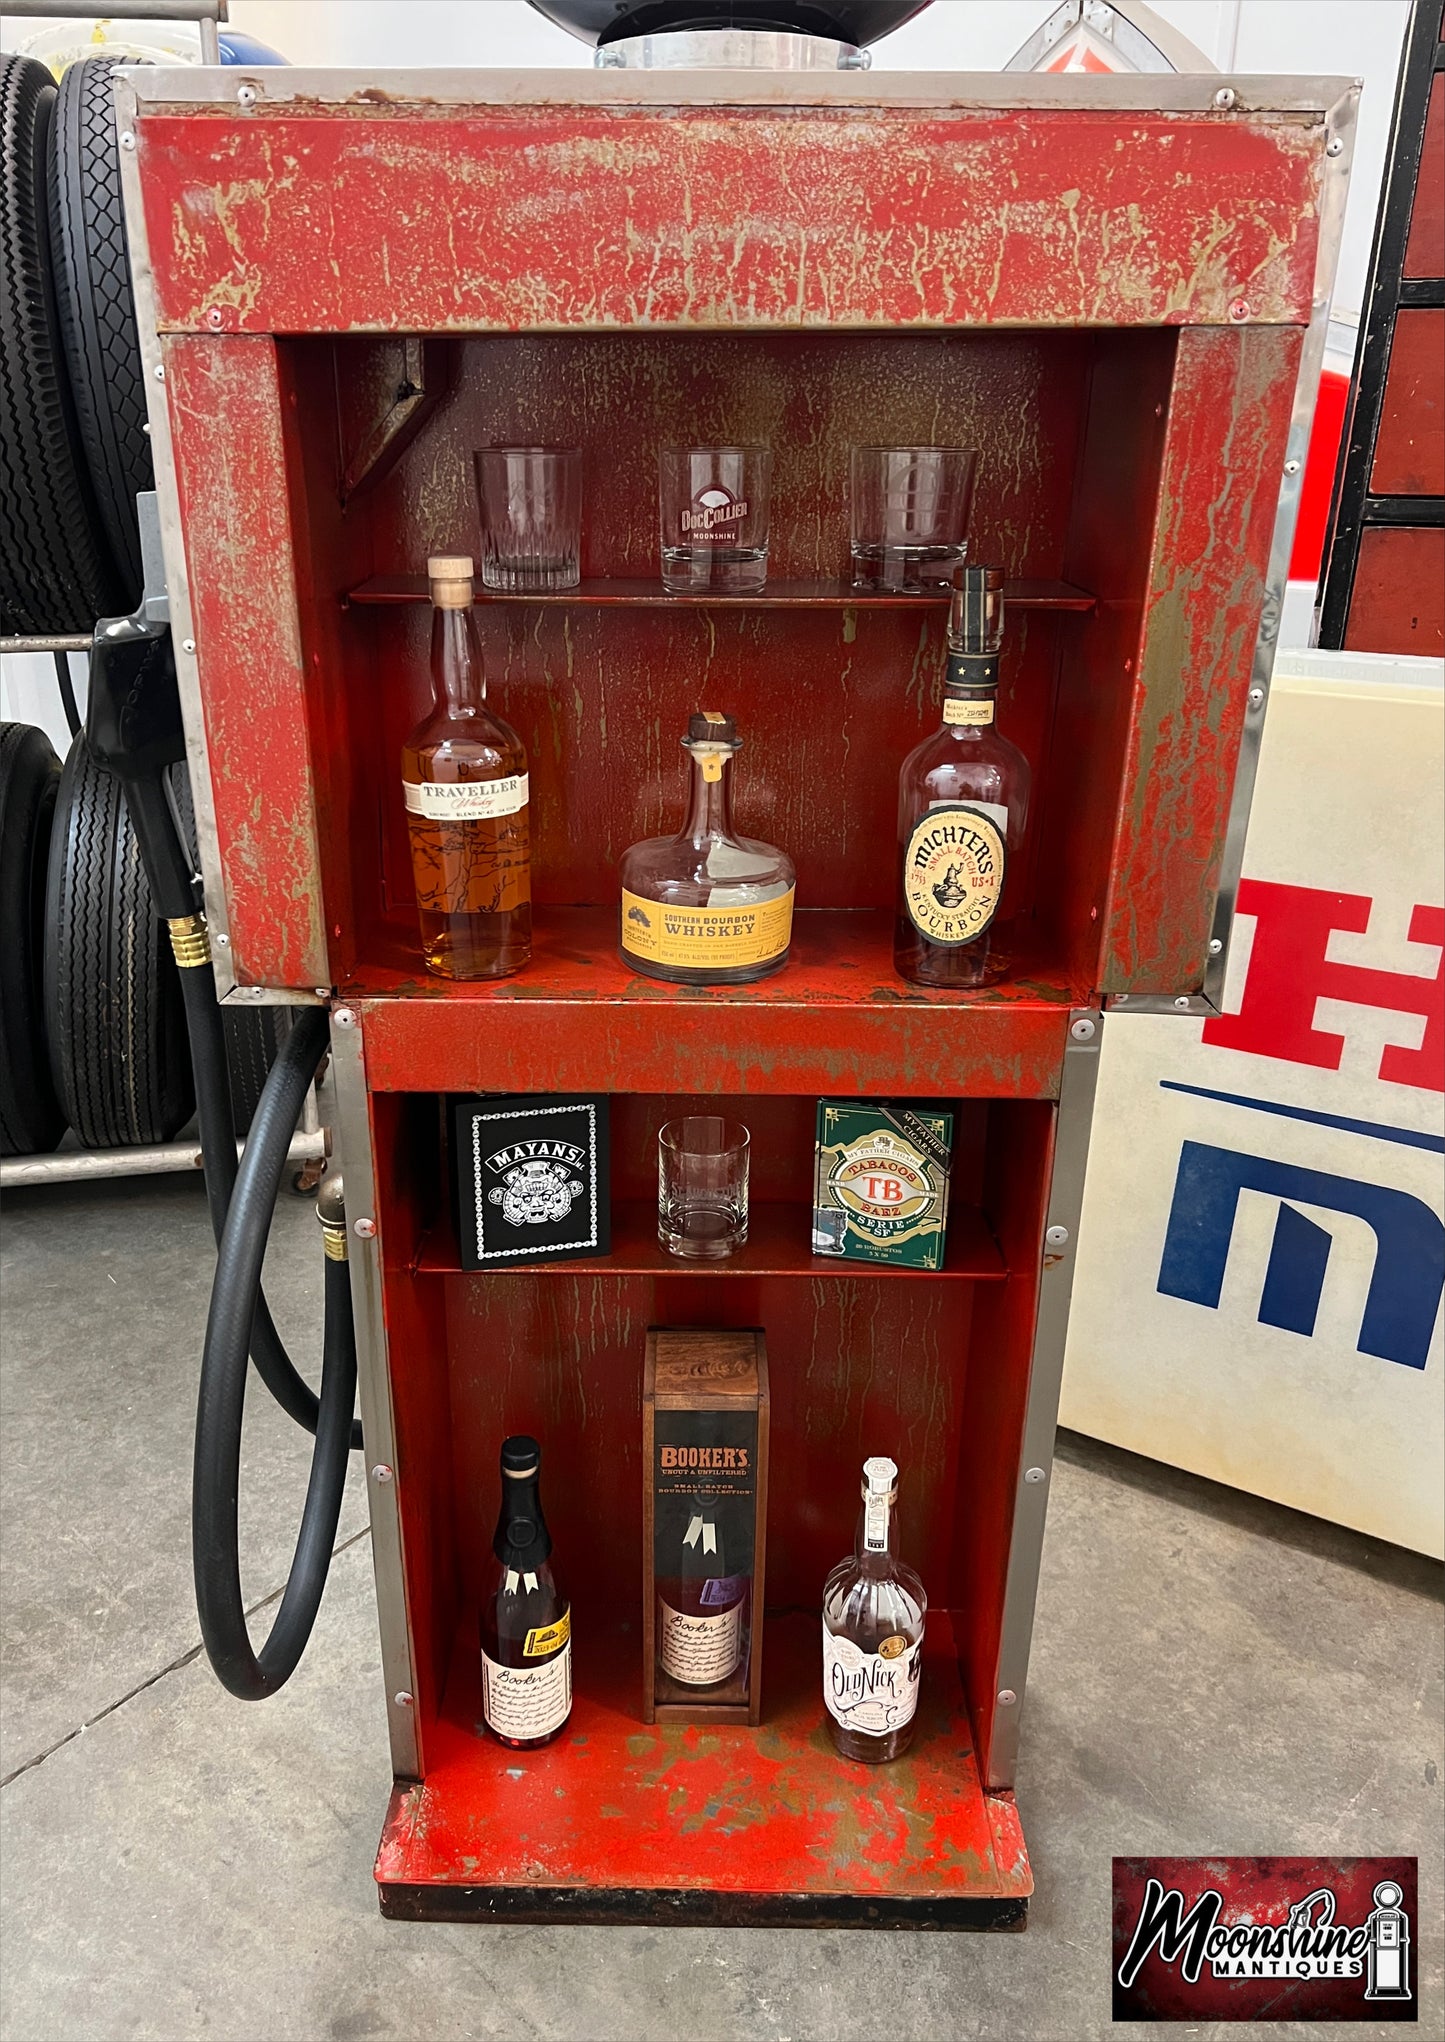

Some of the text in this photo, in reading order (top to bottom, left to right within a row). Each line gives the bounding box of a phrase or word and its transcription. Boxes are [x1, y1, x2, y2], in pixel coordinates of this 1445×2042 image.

[693, 532, 736, 540] MOONSHINE
[423, 779, 518, 798] TRAVELLER
[914, 825, 994, 875] MICHTER'S
[928, 845, 953, 871] SMALL
[955, 846, 977, 874] BATCH
[911, 891, 992, 932] BOURBON
[922, 893, 981, 920] KENTUCKY STRAIGHT
[664, 913, 701, 925] SOUTHERN
[703, 913, 756, 925] BOURBON
[664, 923, 755, 937] WHISKEY
[930, 927, 966, 939] WHISKEY
[902, 1112, 946, 1156] MY FATHER
[903, 1125, 933, 1154] CIGARS
[494, 1142, 579, 1168] MAYANS
[847, 1151, 858, 1159] MY
[848, 1160, 917, 1182] TABACOS
[861, 1175, 904, 1202] TB
[860, 1202, 902, 1217] BAEZ
[857, 1215, 905, 1229] SERIE
[873, 1227, 892, 1237] SF
[661, 1446, 748, 1468] BOOKER'S
[671, 1615, 732, 1633] Booker's
[497, 1663, 559, 1686] Booker's
